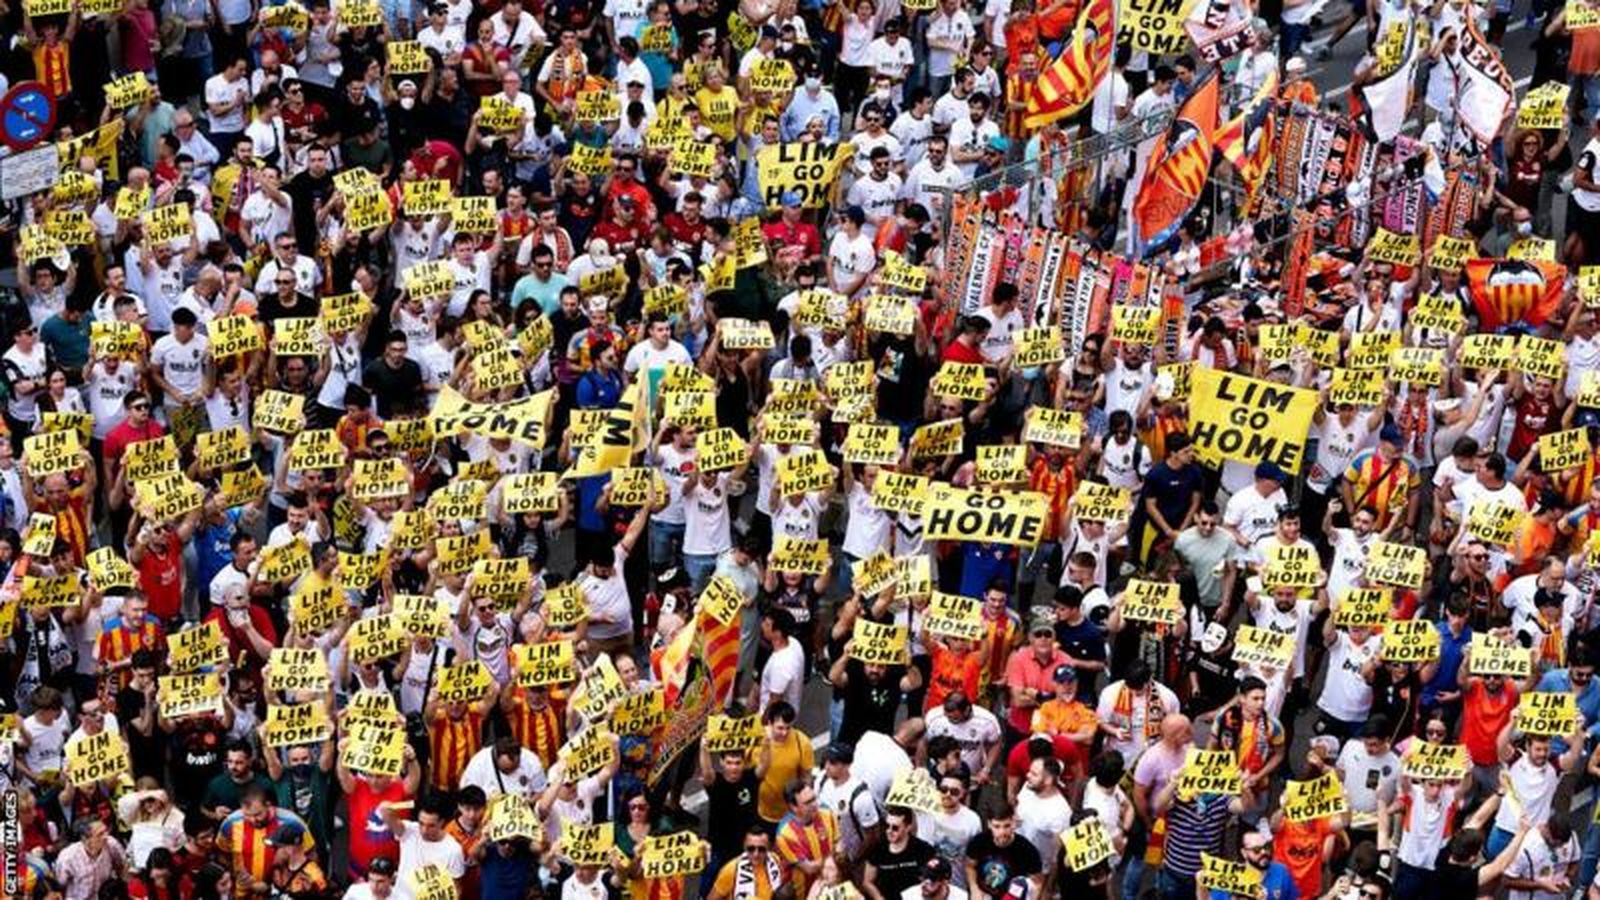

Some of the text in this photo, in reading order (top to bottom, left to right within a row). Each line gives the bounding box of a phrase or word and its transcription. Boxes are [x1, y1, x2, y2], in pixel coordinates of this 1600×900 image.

[1139, 16, 1166, 29] GO
[779, 143, 837, 162] LIM
[794, 165, 824, 180] GO
[412, 182, 441, 194] LIM
[329, 294, 360, 307] LIM
[218, 318, 246, 332] LIM
[284, 319, 315, 331] LIM
[1361, 333, 1390, 344] LIM
[1474, 338, 1504, 348] LIM
[214, 339, 258, 355] HOME
[1525, 339, 1556, 354] LIM
[835, 364, 865, 376] LIM
[947, 366, 979, 376] LIM
[1342, 370, 1372, 380] LIM
[1216, 376, 1295, 412] LIM
[1230, 407, 1269, 431] GO
[300, 432, 331, 444] LIM
[705, 431, 733, 445] LIM
[765, 429, 813, 441] HOME
[856, 427, 888, 440] LIM
[1550, 432, 1580, 448] LIM
[35, 432, 66, 449] LIM
[1191, 421, 1301, 469] HOME
[135, 441, 166, 454] LIM
[984, 448, 1016, 459] LIM
[701, 452, 744, 469] HOME
[787, 454, 817, 470] LIM
[362, 462, 394, 474] LIM
[514, 475, 544, 487] LIM
[886, 475, 917, 487] LIM
[1088, 486, 1119, 498] LIM
[966, 494, 1005, 510] GO
[928, 509, 1041, 541] HOME
[1277, 547, 1310, 559] LIM
[1381, 546, 1417, 560] LIM
[484, 562, 518, 573] LIM
[1135, 583, 1169, 597] LIM
[1347, 591, 1384, 602] LIM
[404, 599, 437, 611] LIM
[940, 599, 973, 612] LIM
[359, 619, 390, 635] LIM
[863, 627, 896, 639] LIM
[1394, 622, 1428, 634] LIM
[181, 627, 211, 645] LIM
[281, 651, 316, 664] LIM
[528, 645, 560, 660] LIM
[171, 676, 206, 688] LIM
[355, 696, 389, 709] LIM
[1531, 695, 1565, 708] LIM
[276, 706, 311, 720] LIM
[720, 719, 754, 731] LIM
[77, 734, 110, 756] LIM
[1420, 744, 1456, 758] LIM
[1195, 752, 1231, 765] LIM
[655, 833, 690, 848] LIM
